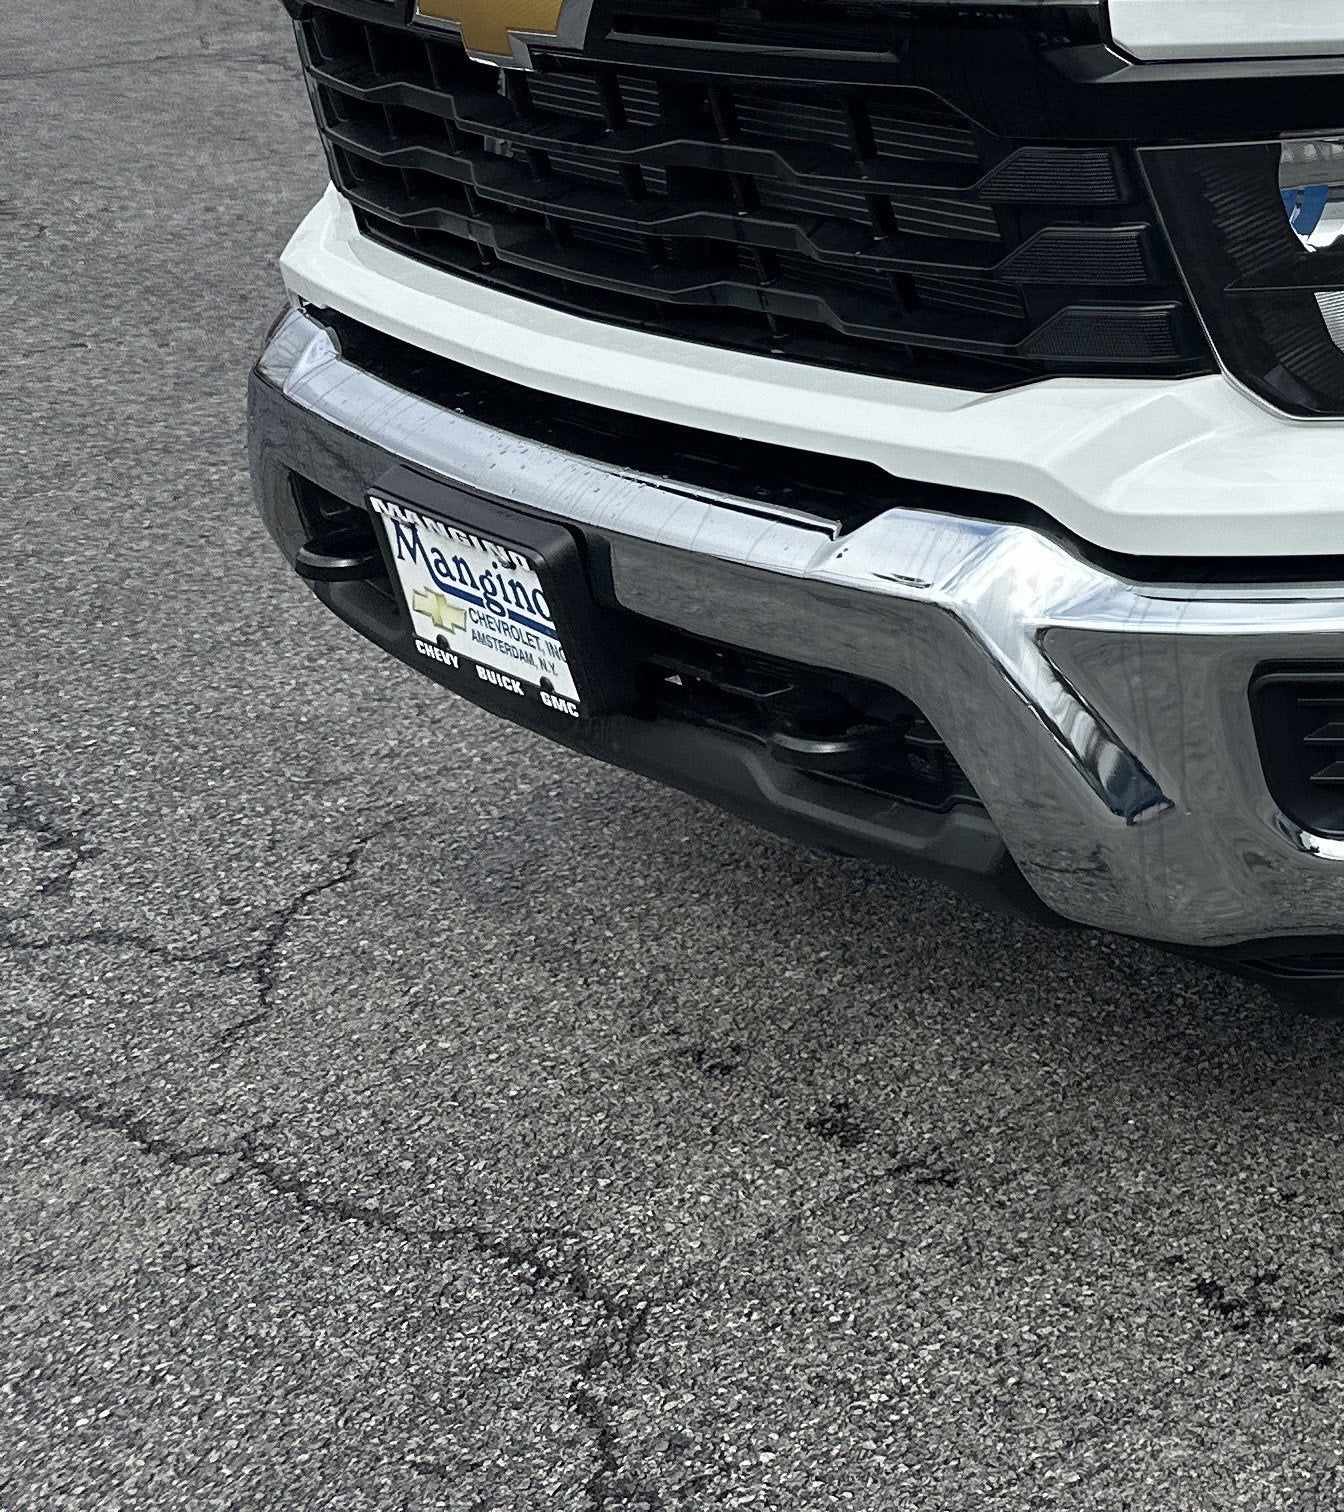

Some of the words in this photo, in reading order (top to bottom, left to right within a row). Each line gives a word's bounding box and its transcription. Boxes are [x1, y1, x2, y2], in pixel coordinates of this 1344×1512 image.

[369, 496, 532, 572] MANGINO
[392, 518, 553, 621] Mangino
[468, 606, 545, 656] CHEVROLET,
[415, 638, 460, 669] CHEVY
[475, 664, 525, 696] BUICK
[539, 690, 580, 718] GMC
